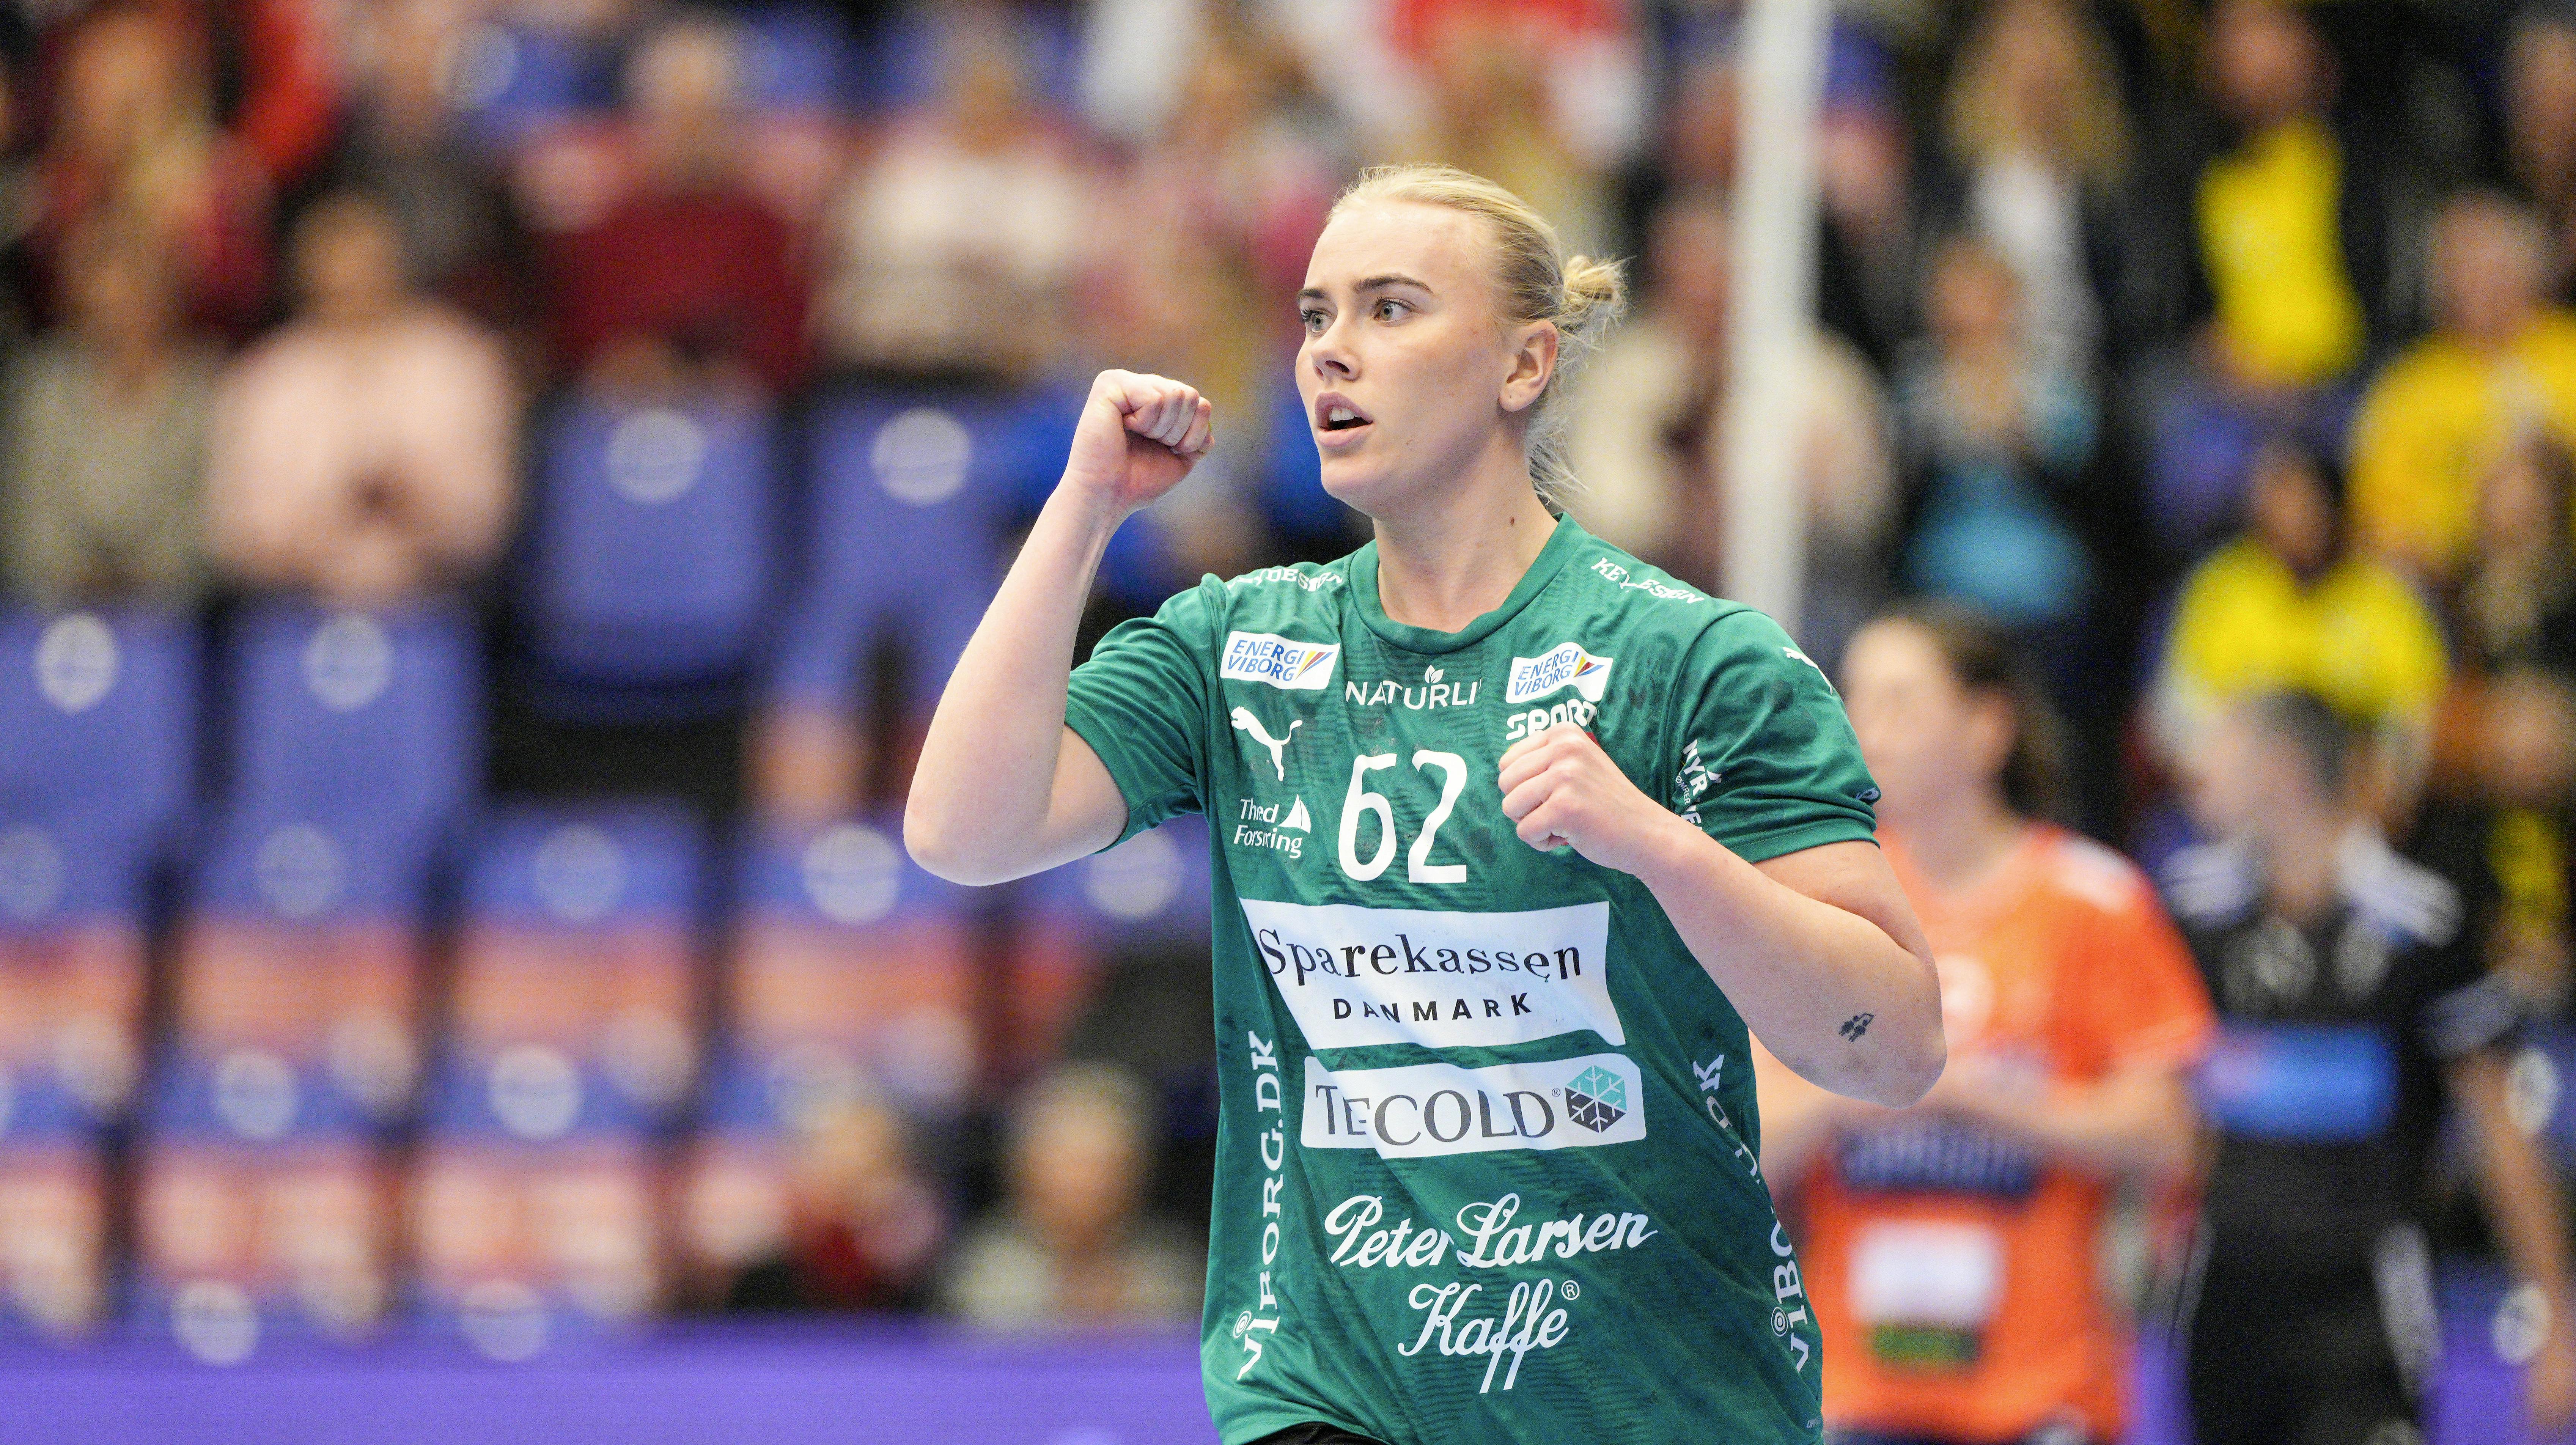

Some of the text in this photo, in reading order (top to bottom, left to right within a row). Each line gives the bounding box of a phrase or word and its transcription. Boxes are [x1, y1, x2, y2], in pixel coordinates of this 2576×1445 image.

[1228, 654, 1297, 681] VIBORG
[1233, 639, 1305, 665] ENERGI
[1518, 649, 1579, 680] ENERGI
[1515, 665, 1573, 696] VIBORG
[1675, 772, 1691, 805] ØMRER
[1338, 749, 1467, 883] 62
[1259, 929, 1581, 986] Sparekassen
[1333, 992, 1532, 1023] DANMARK
[1324, 1192, 1658, 1268] Peter Larsen
